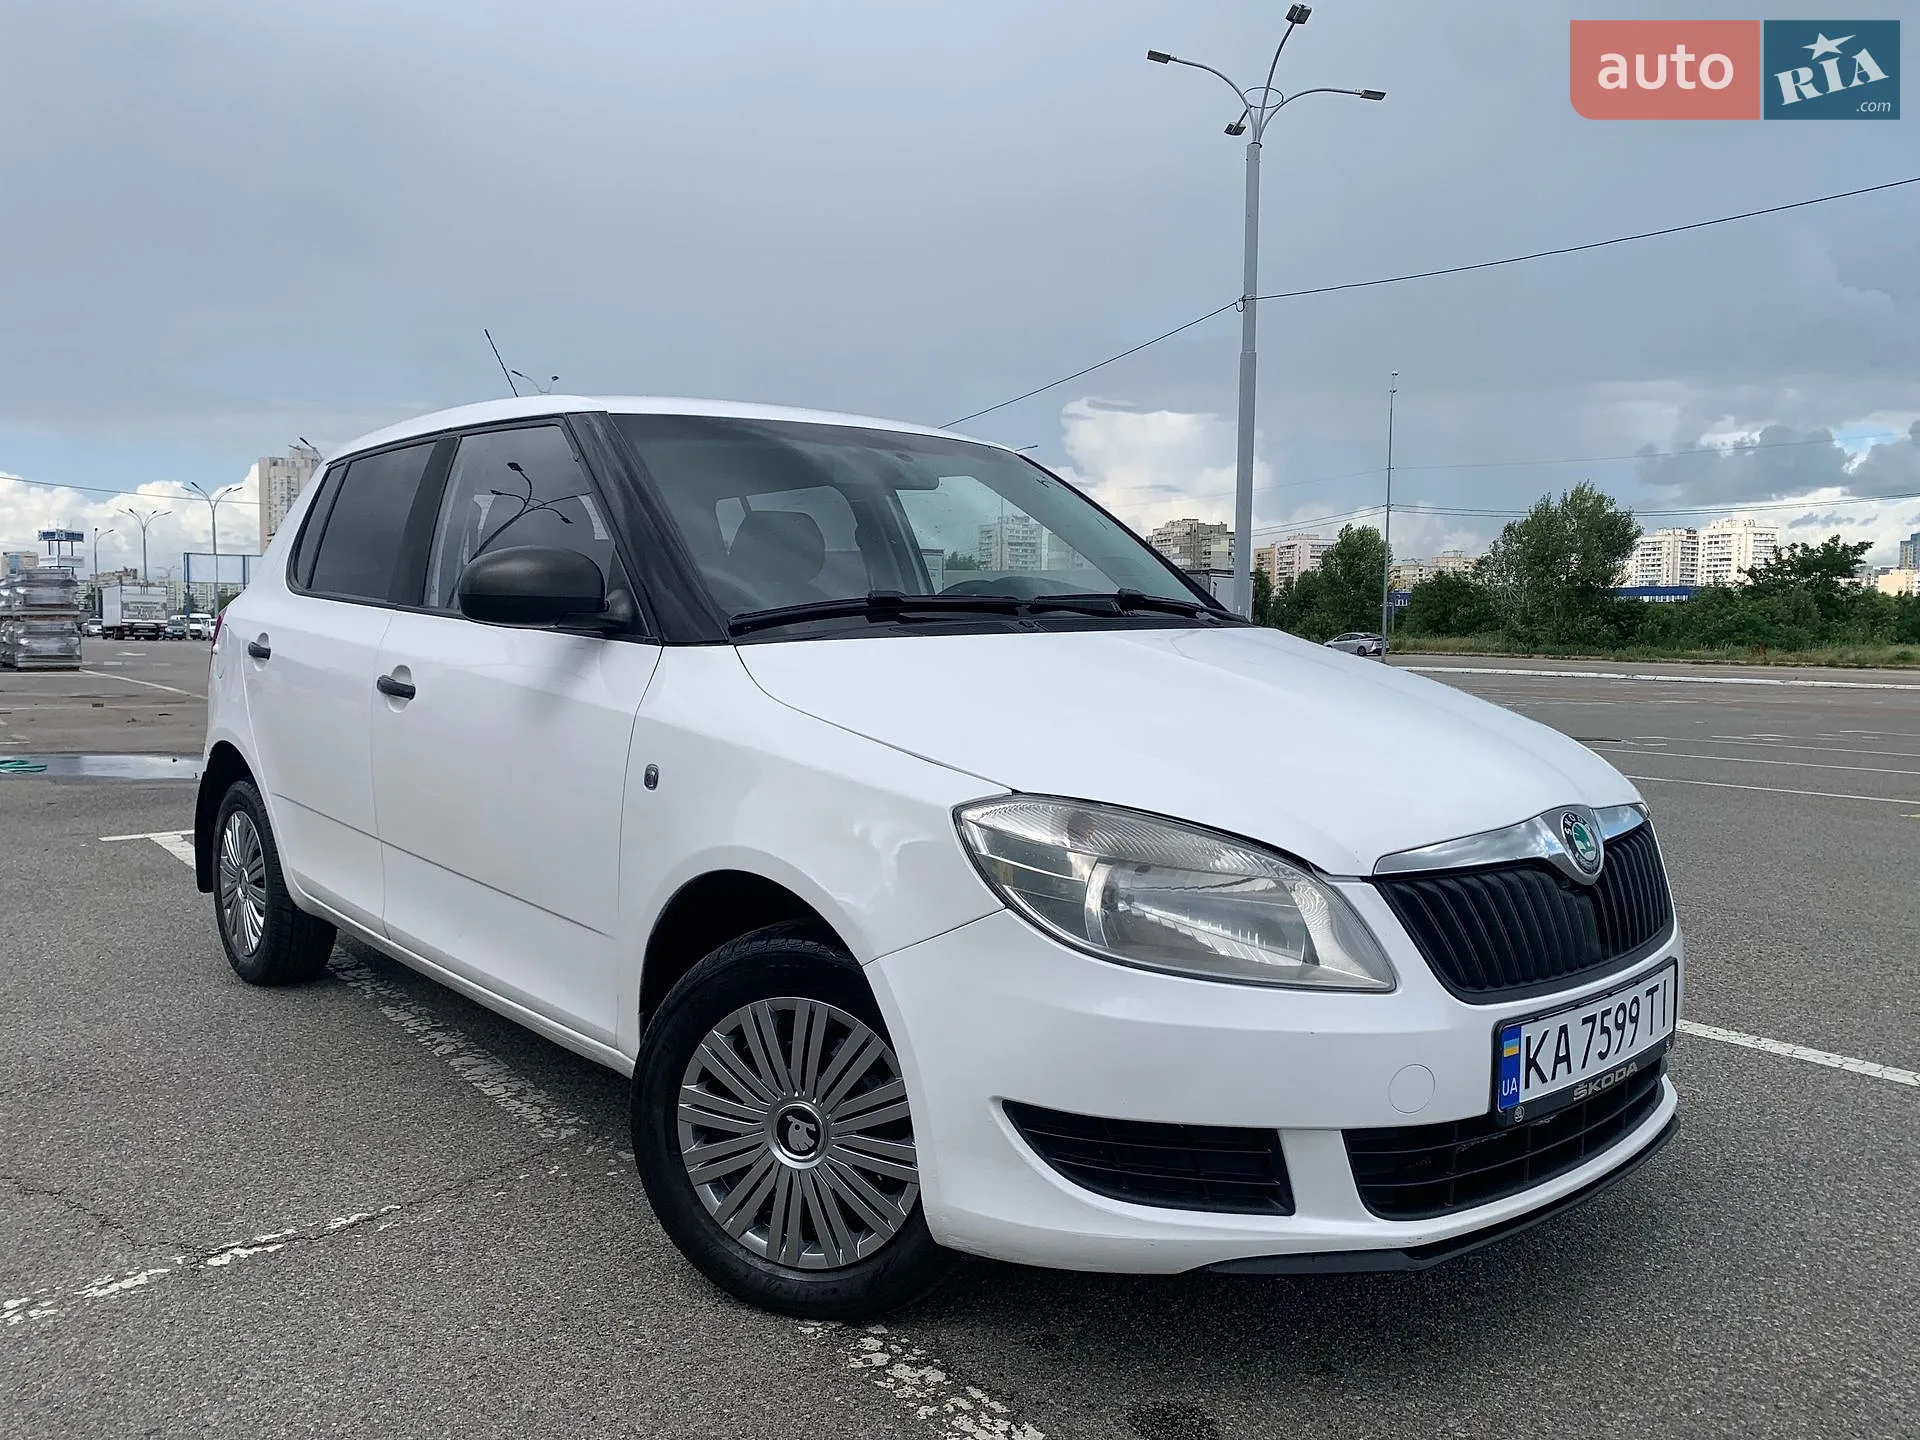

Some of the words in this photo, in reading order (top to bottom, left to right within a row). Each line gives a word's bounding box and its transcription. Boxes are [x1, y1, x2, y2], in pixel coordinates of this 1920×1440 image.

[1524, 1023, 1573, 1090] KA
[1580, 995, 1641, 1070] 7599
[1645, 979, 1667, 1036] TI
[1502, 1077, 1518, 1096] UA
